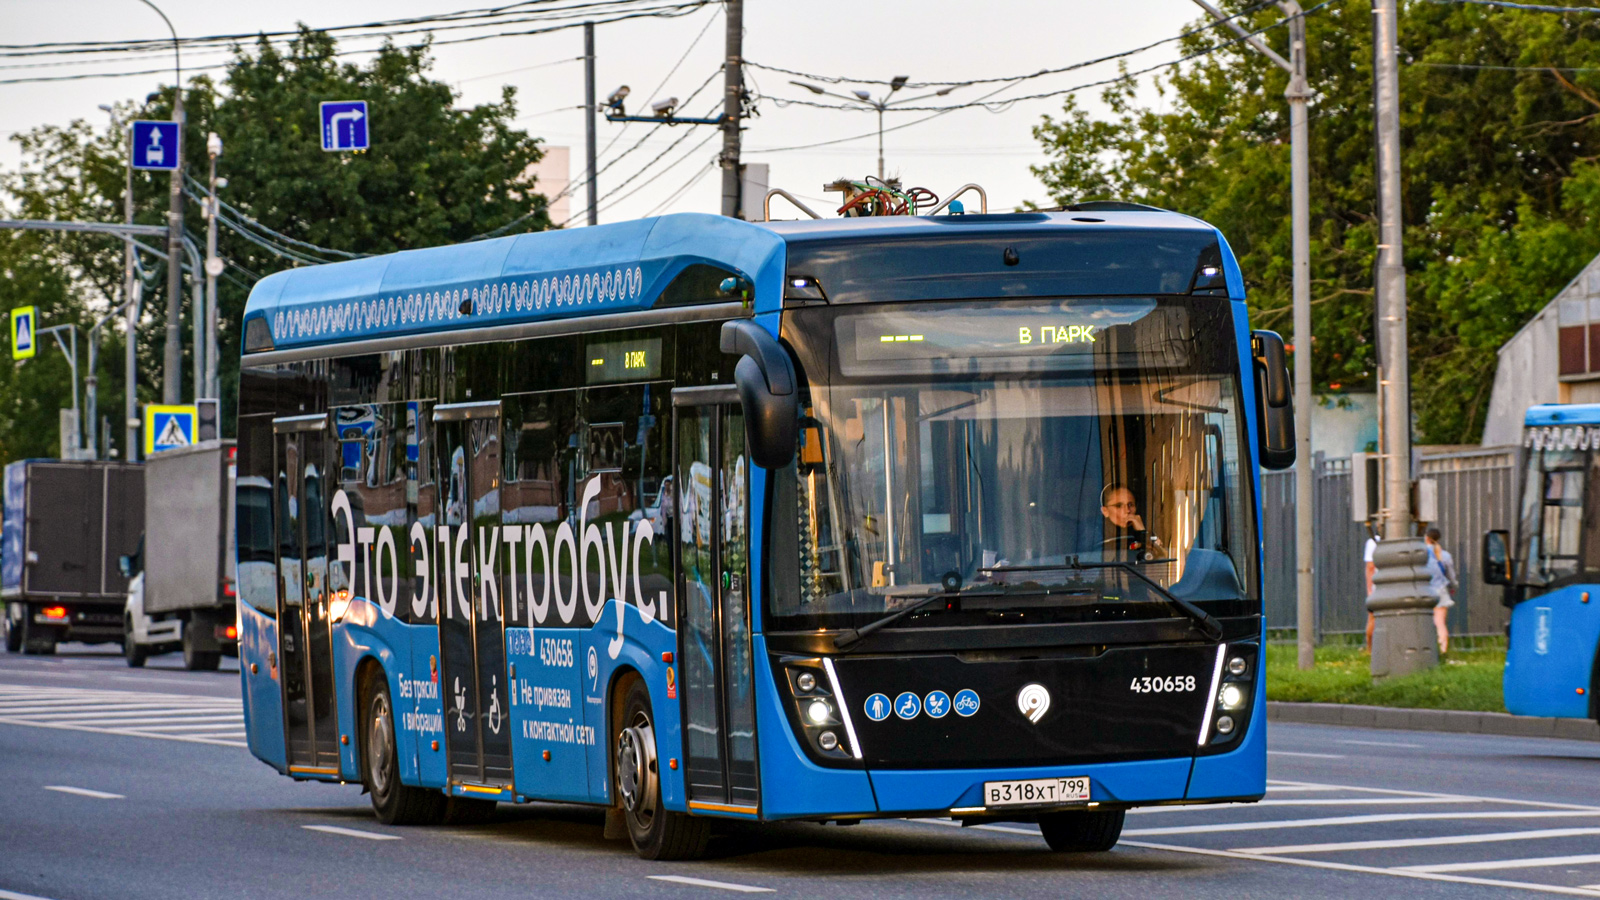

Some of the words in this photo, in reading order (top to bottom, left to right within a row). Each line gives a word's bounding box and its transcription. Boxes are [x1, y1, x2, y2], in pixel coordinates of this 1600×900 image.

[1019, 326, 1032, 344] В
[1040, 325, 1096, 344] ПАРК
[630, 351, 646, 368] ПАРК
[331, 489, 398, 619] Это
[410, 473, 668, 660] электробус.
[540, 638, 574, 668] 430658
[398, 673, 413, 698] Без
[413, 680, 438, 704] тряски
[521, 679, 533, 705] Не
[534, 686, 571, 712] привязан
[1130, 675, 1196, 693] 430658
[407, 706, 443, 737] вибраций
[522, 719, 528, 738] к
[529, 717, 575, 743] контактной
[576, 724, 596, 746] сети
